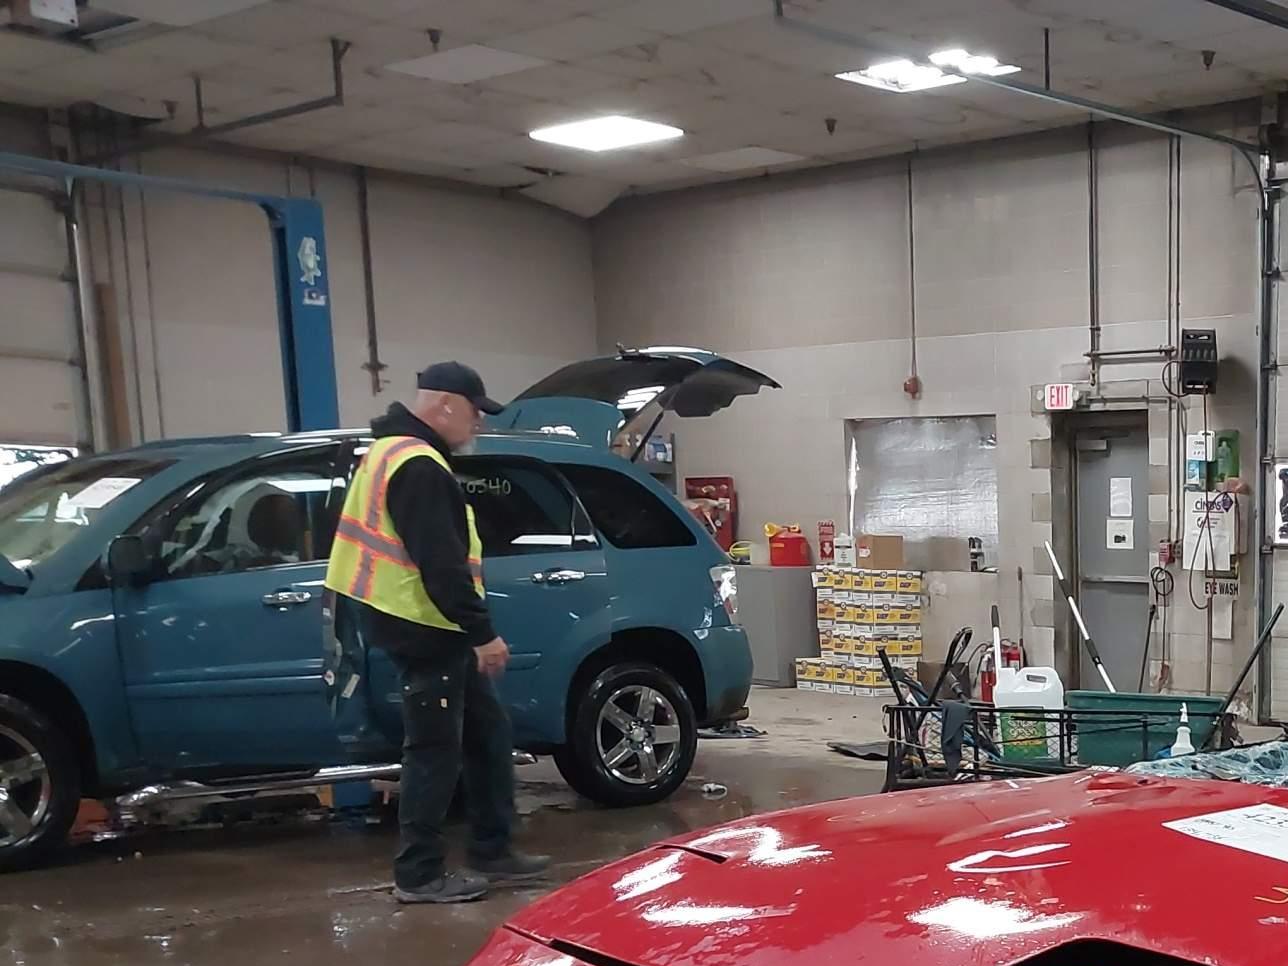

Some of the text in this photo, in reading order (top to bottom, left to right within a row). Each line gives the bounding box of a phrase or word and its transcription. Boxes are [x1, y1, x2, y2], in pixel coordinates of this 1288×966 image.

[1050, 385, 1069, 407] EXIT
[1205, 581, 1239, 595] EYE WASH
